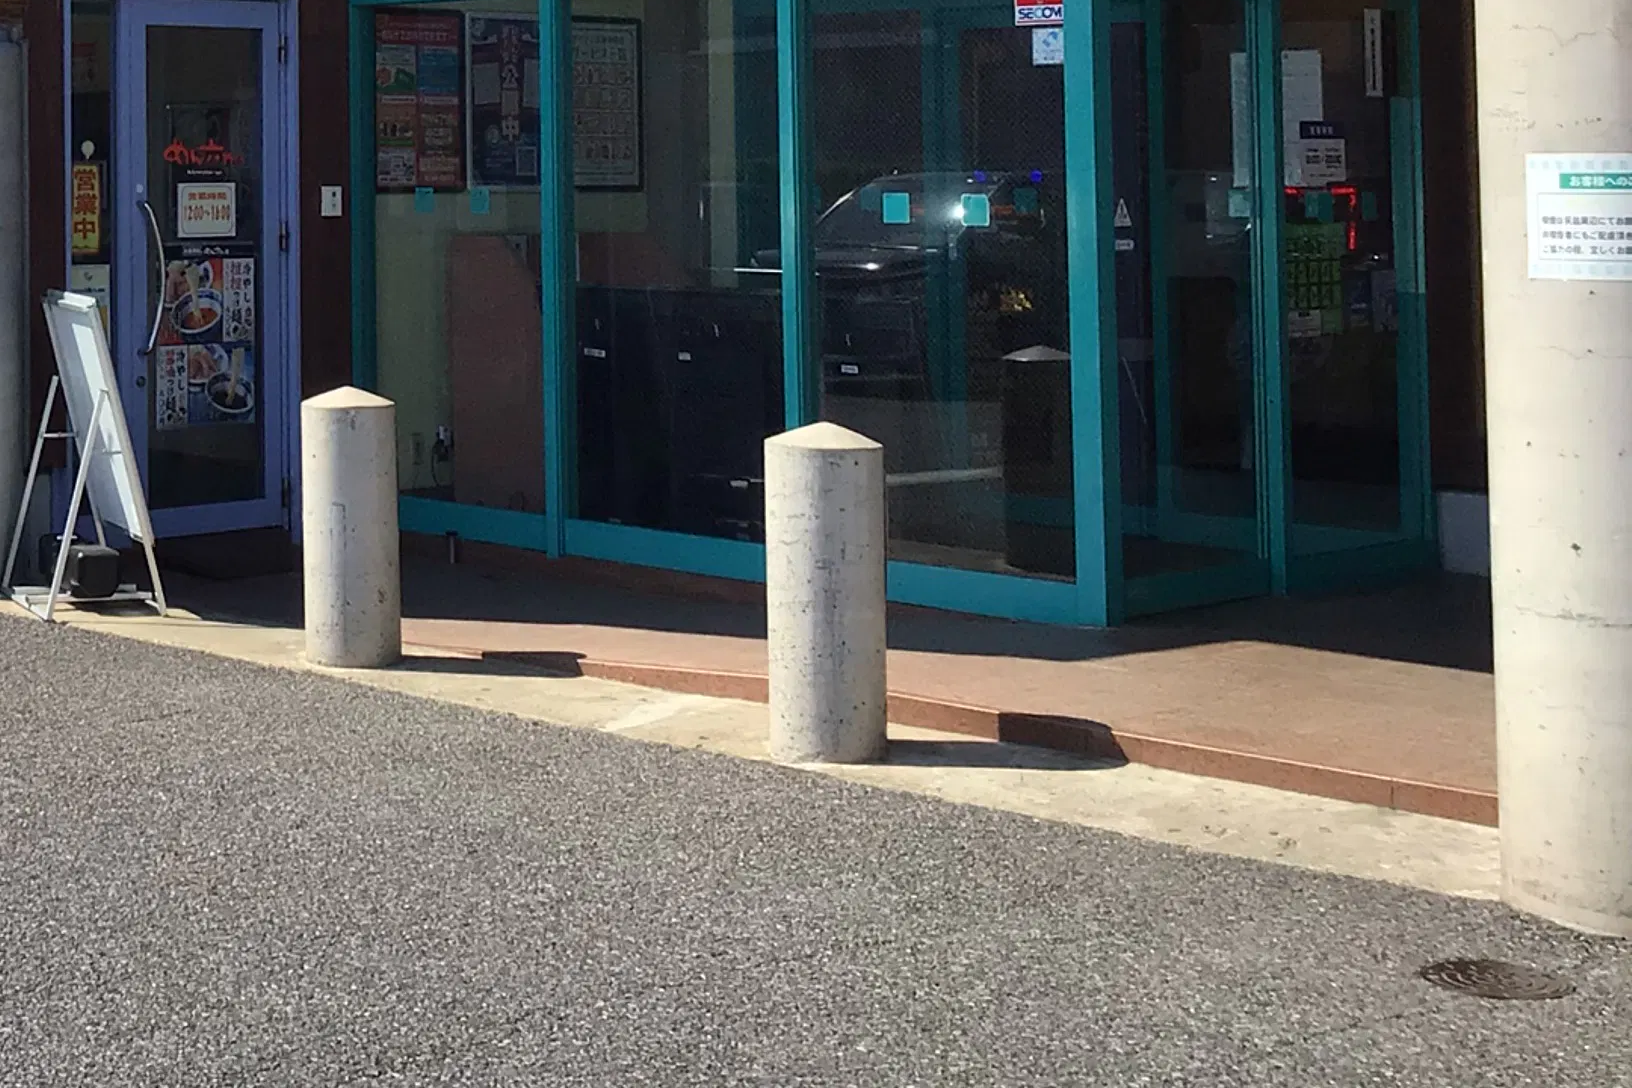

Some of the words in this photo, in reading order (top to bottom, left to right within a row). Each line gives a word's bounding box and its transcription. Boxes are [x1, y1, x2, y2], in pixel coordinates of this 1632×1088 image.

[1018, 7, 1063, 19] SECOM
[72, 168, 99, 240] 営業中
